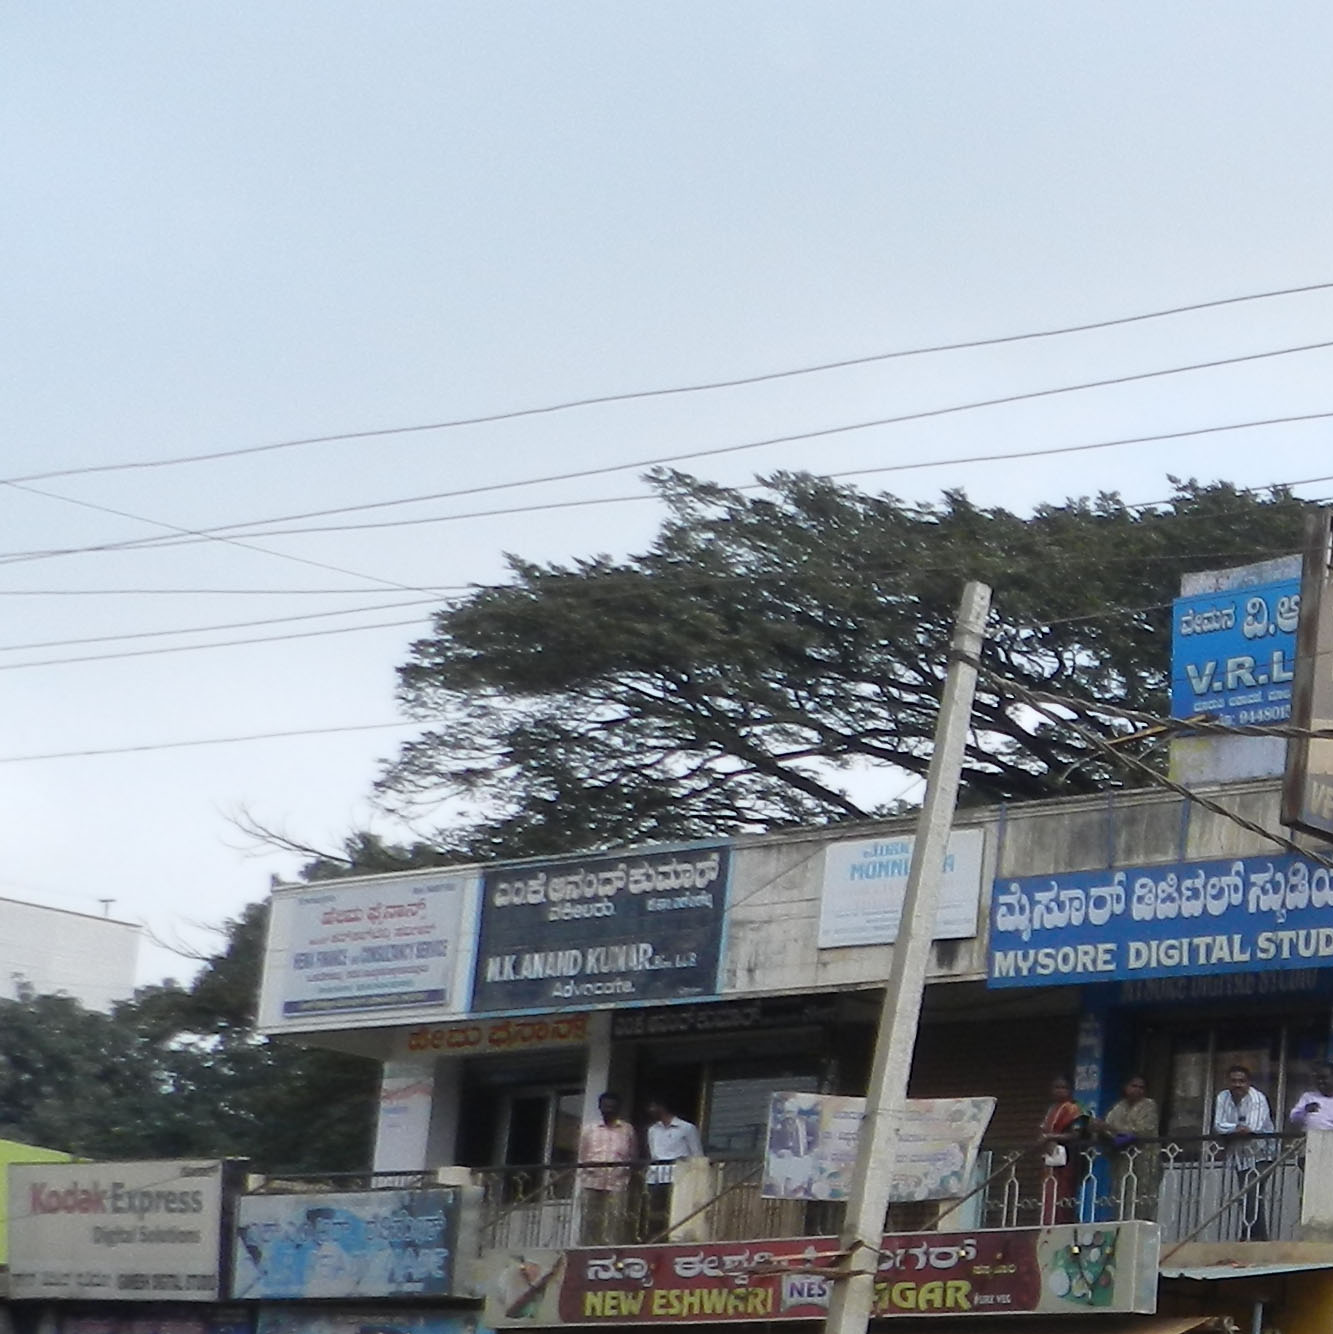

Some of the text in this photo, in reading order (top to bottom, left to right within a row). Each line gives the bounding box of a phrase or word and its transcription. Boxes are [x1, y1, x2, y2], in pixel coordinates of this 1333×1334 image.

[993, 943, 1117, 979] MYSORE
[1128, 934, 1251, 971] DIGITAL
[30, 1181, 203, 1220] Kodak Express
[584, 1291, 645, 1317] NEW
[652, 1287, 774, 1317] ESHWARI
